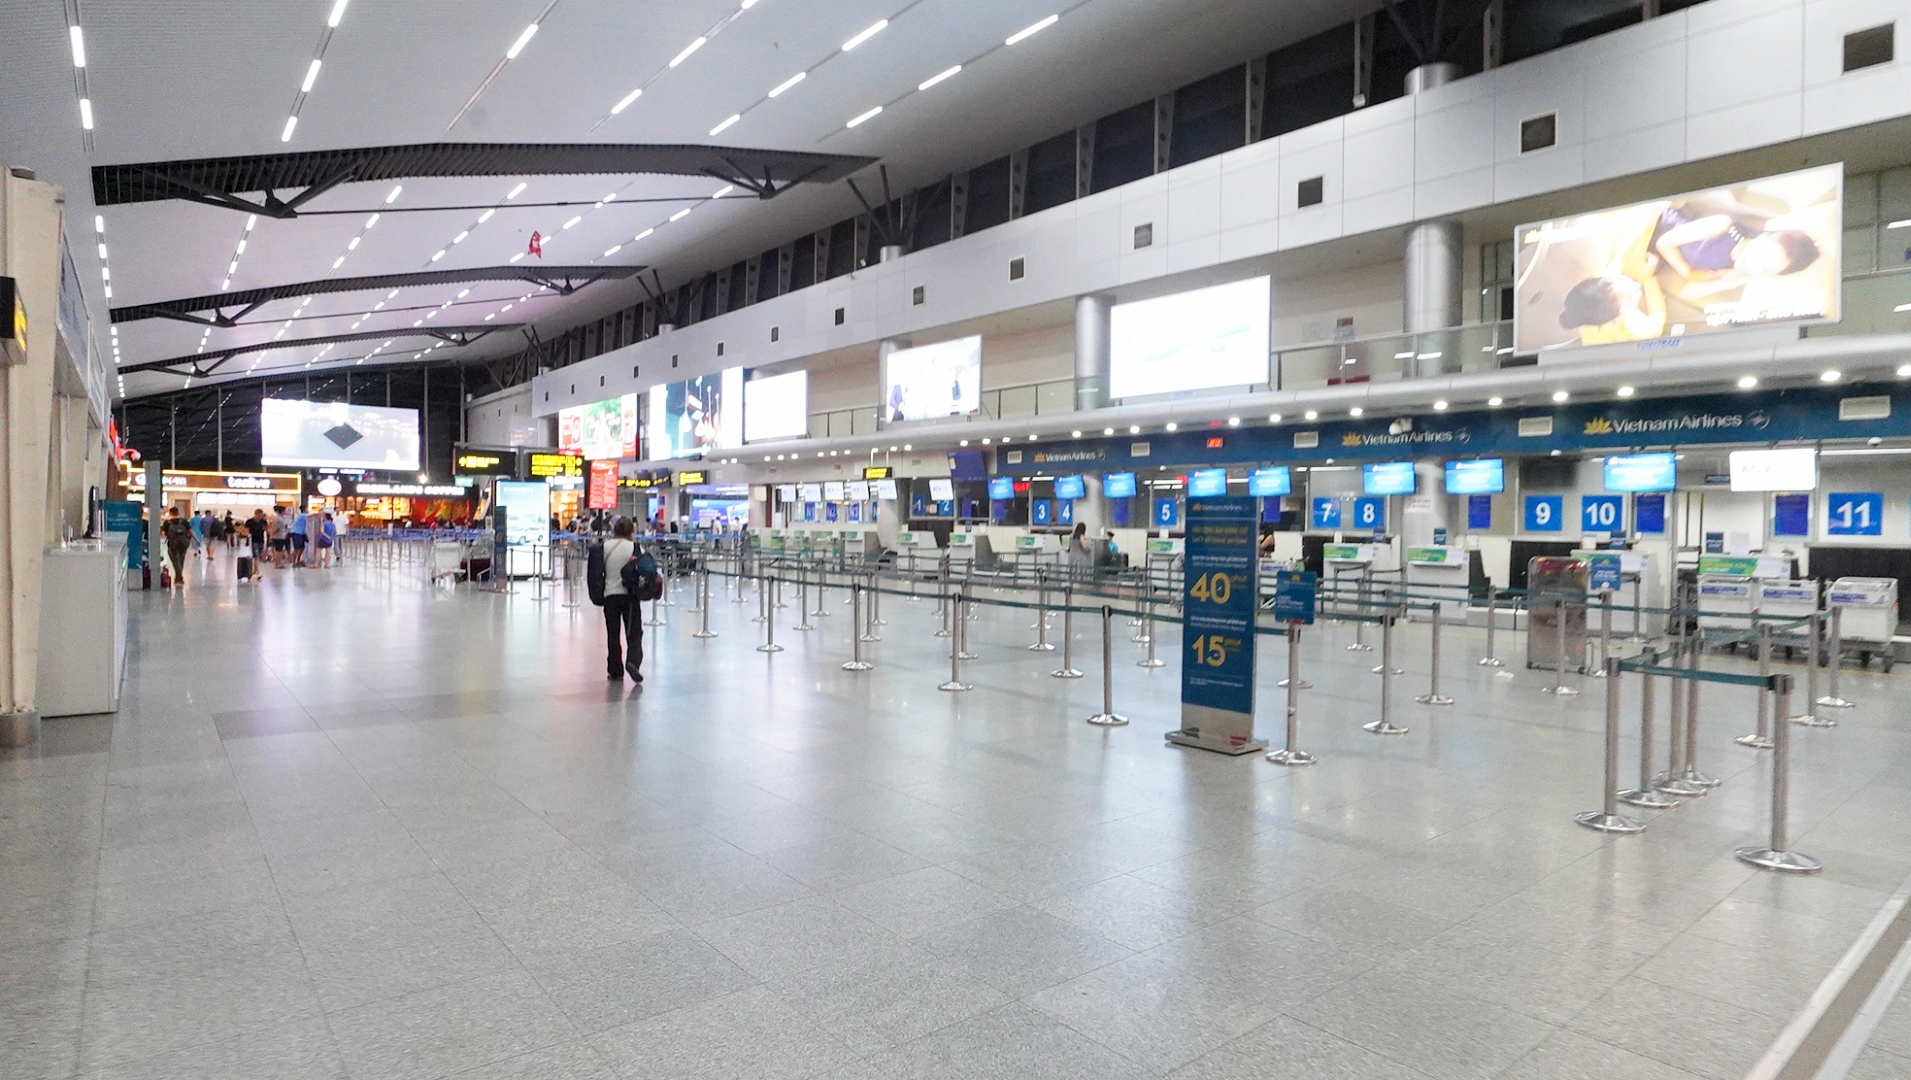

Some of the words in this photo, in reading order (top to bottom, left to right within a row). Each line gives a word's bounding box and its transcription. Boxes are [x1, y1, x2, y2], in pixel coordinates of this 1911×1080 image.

[1612, 418, 1679, 434] Vietnam
[1679, 413, 1743, 430] Airlines
[1362, 432, 1408, 447] Vietnam
[1407, 429, 1453, 443] Airlines
[1045, 452, 1072, 463] Vietnam
[1071, 451, 1096, 461] Airlines
[1037, 503, 1046, 520] 3
[1061, 503, 1070, 519] 4
[1161, 503, 1170, 521] 5
[1321, 503, 1332, 522] 7
[1363, 503, 1375, 523] 8
[1535, 502, 1551, 525] 9
[1585, 502, 1615, 526] 10
[1836, 501, 1873, 528] 11
[1189, 571, 1231, 604] 40
[1191, 633, 1226, 667] 15
